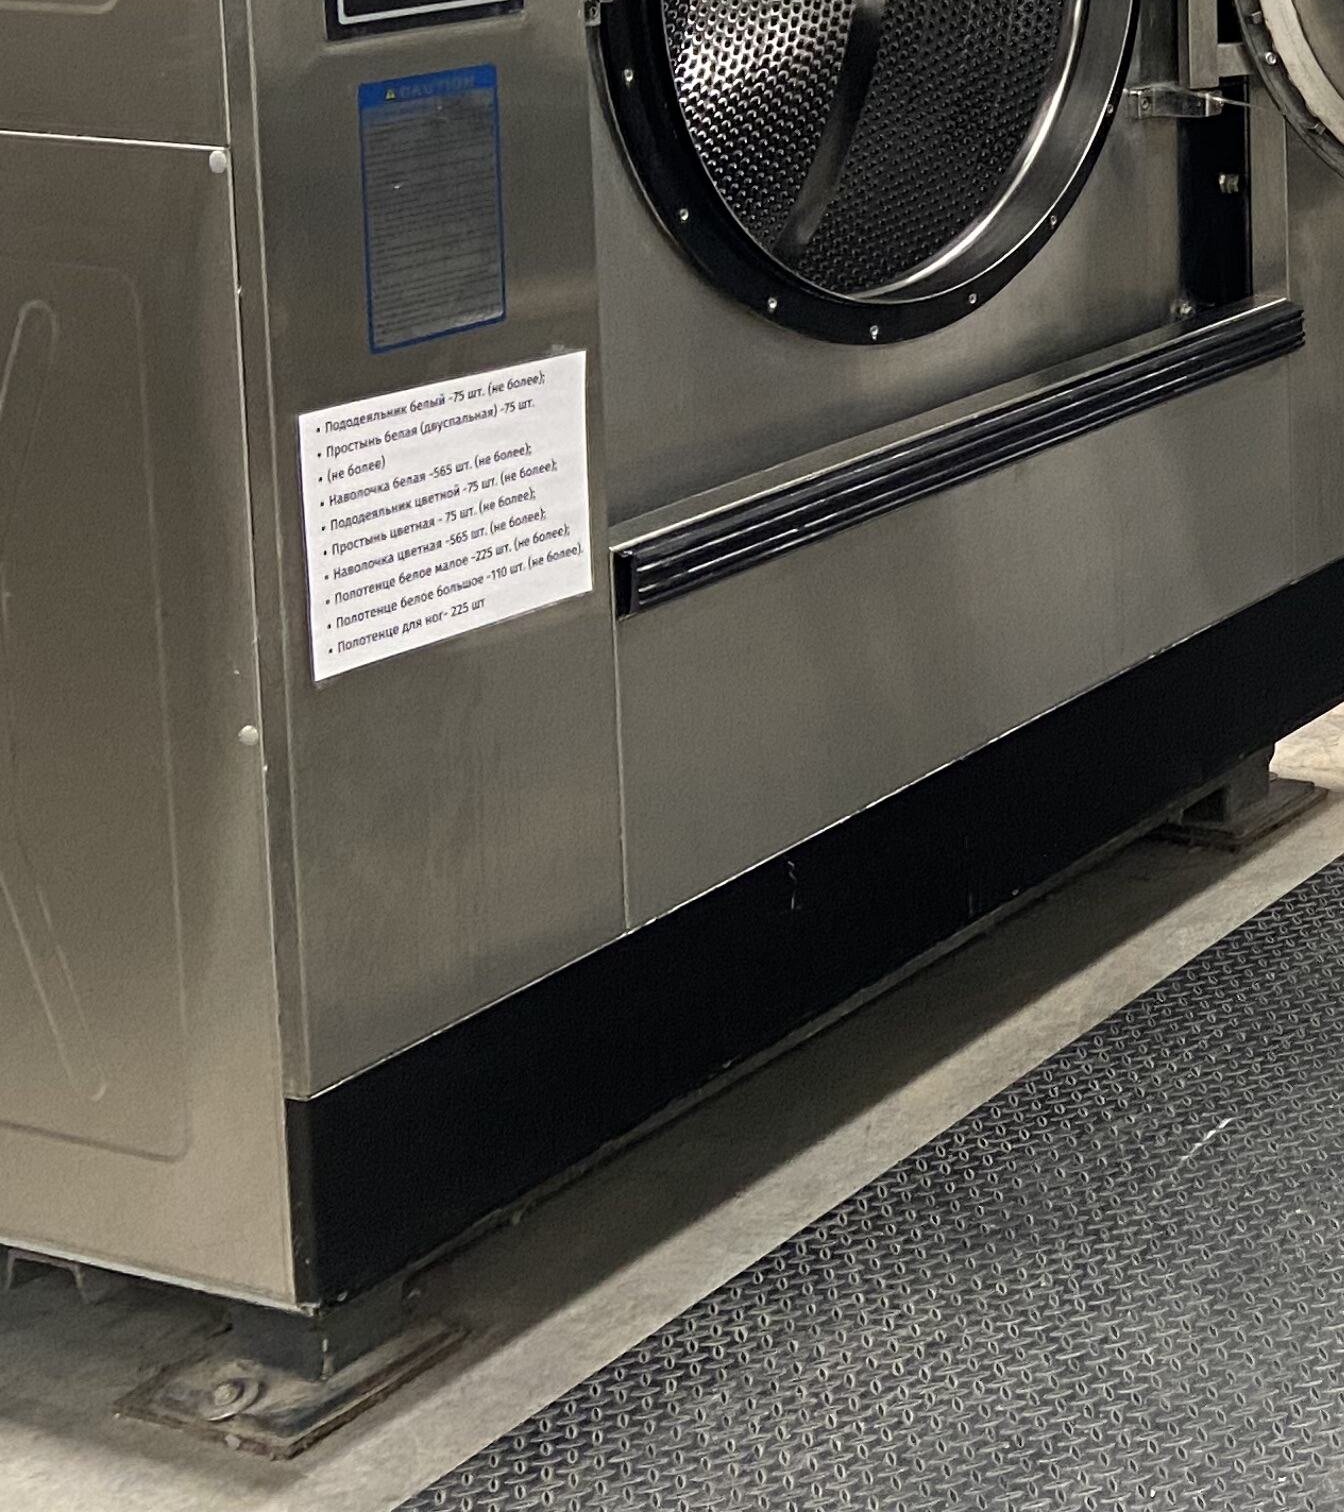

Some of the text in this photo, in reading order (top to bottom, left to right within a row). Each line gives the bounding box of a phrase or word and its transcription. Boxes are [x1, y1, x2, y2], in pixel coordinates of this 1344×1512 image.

[325, 405, 408, 433] Пододеяльник
[410, 393, 445, 413] белый
[468, 387, 485, 399] шт.
[488, 382, 504, 397] (не
[326, 437, 382, 458] Простынь
[384, 427, 418, 443] белая
[420, 404, 498, 435] (двуспальная)
[327, 455, 386, 484] (не более)
[329, 479, 390, 506] Наволочка
[392, 471, 426, 488] белая
[429, 465, 453, 479] -565
[474, 454, 491, 469] (не
[330, 501, 412, 531] Пододеяльник
[415, 483, 460, 508] цветной
[500, 471, 517, 486] (не
[332, 532, 387, 556] Простынь
[390, 516, 435, 539] цветная
[479, 500, 495, 515] (не
[333, 554, 394, 580] Наволочка
[397, 539, 442, 561] цветная
[445, 531, 467, 546] -565
[490, 521, 507, 535] (не
[334, 577, 395, 605] Полотенце
[399, 565, 432, 585] белое
[435, 555, 468, 573] малое
[471, 546, 492, 563] -225
[514, 536, 530, 552] (не
[336, 601, 398, 629] Полотенце
[400, 588, 434, 609] белое
[436, 576, 484, 598] большое
[528, 556, 544, 570] (не
[337, 625, 399, 654] Полотенце
[402, 617, 422, 635] для
[451, 601, 469, 617] 225
